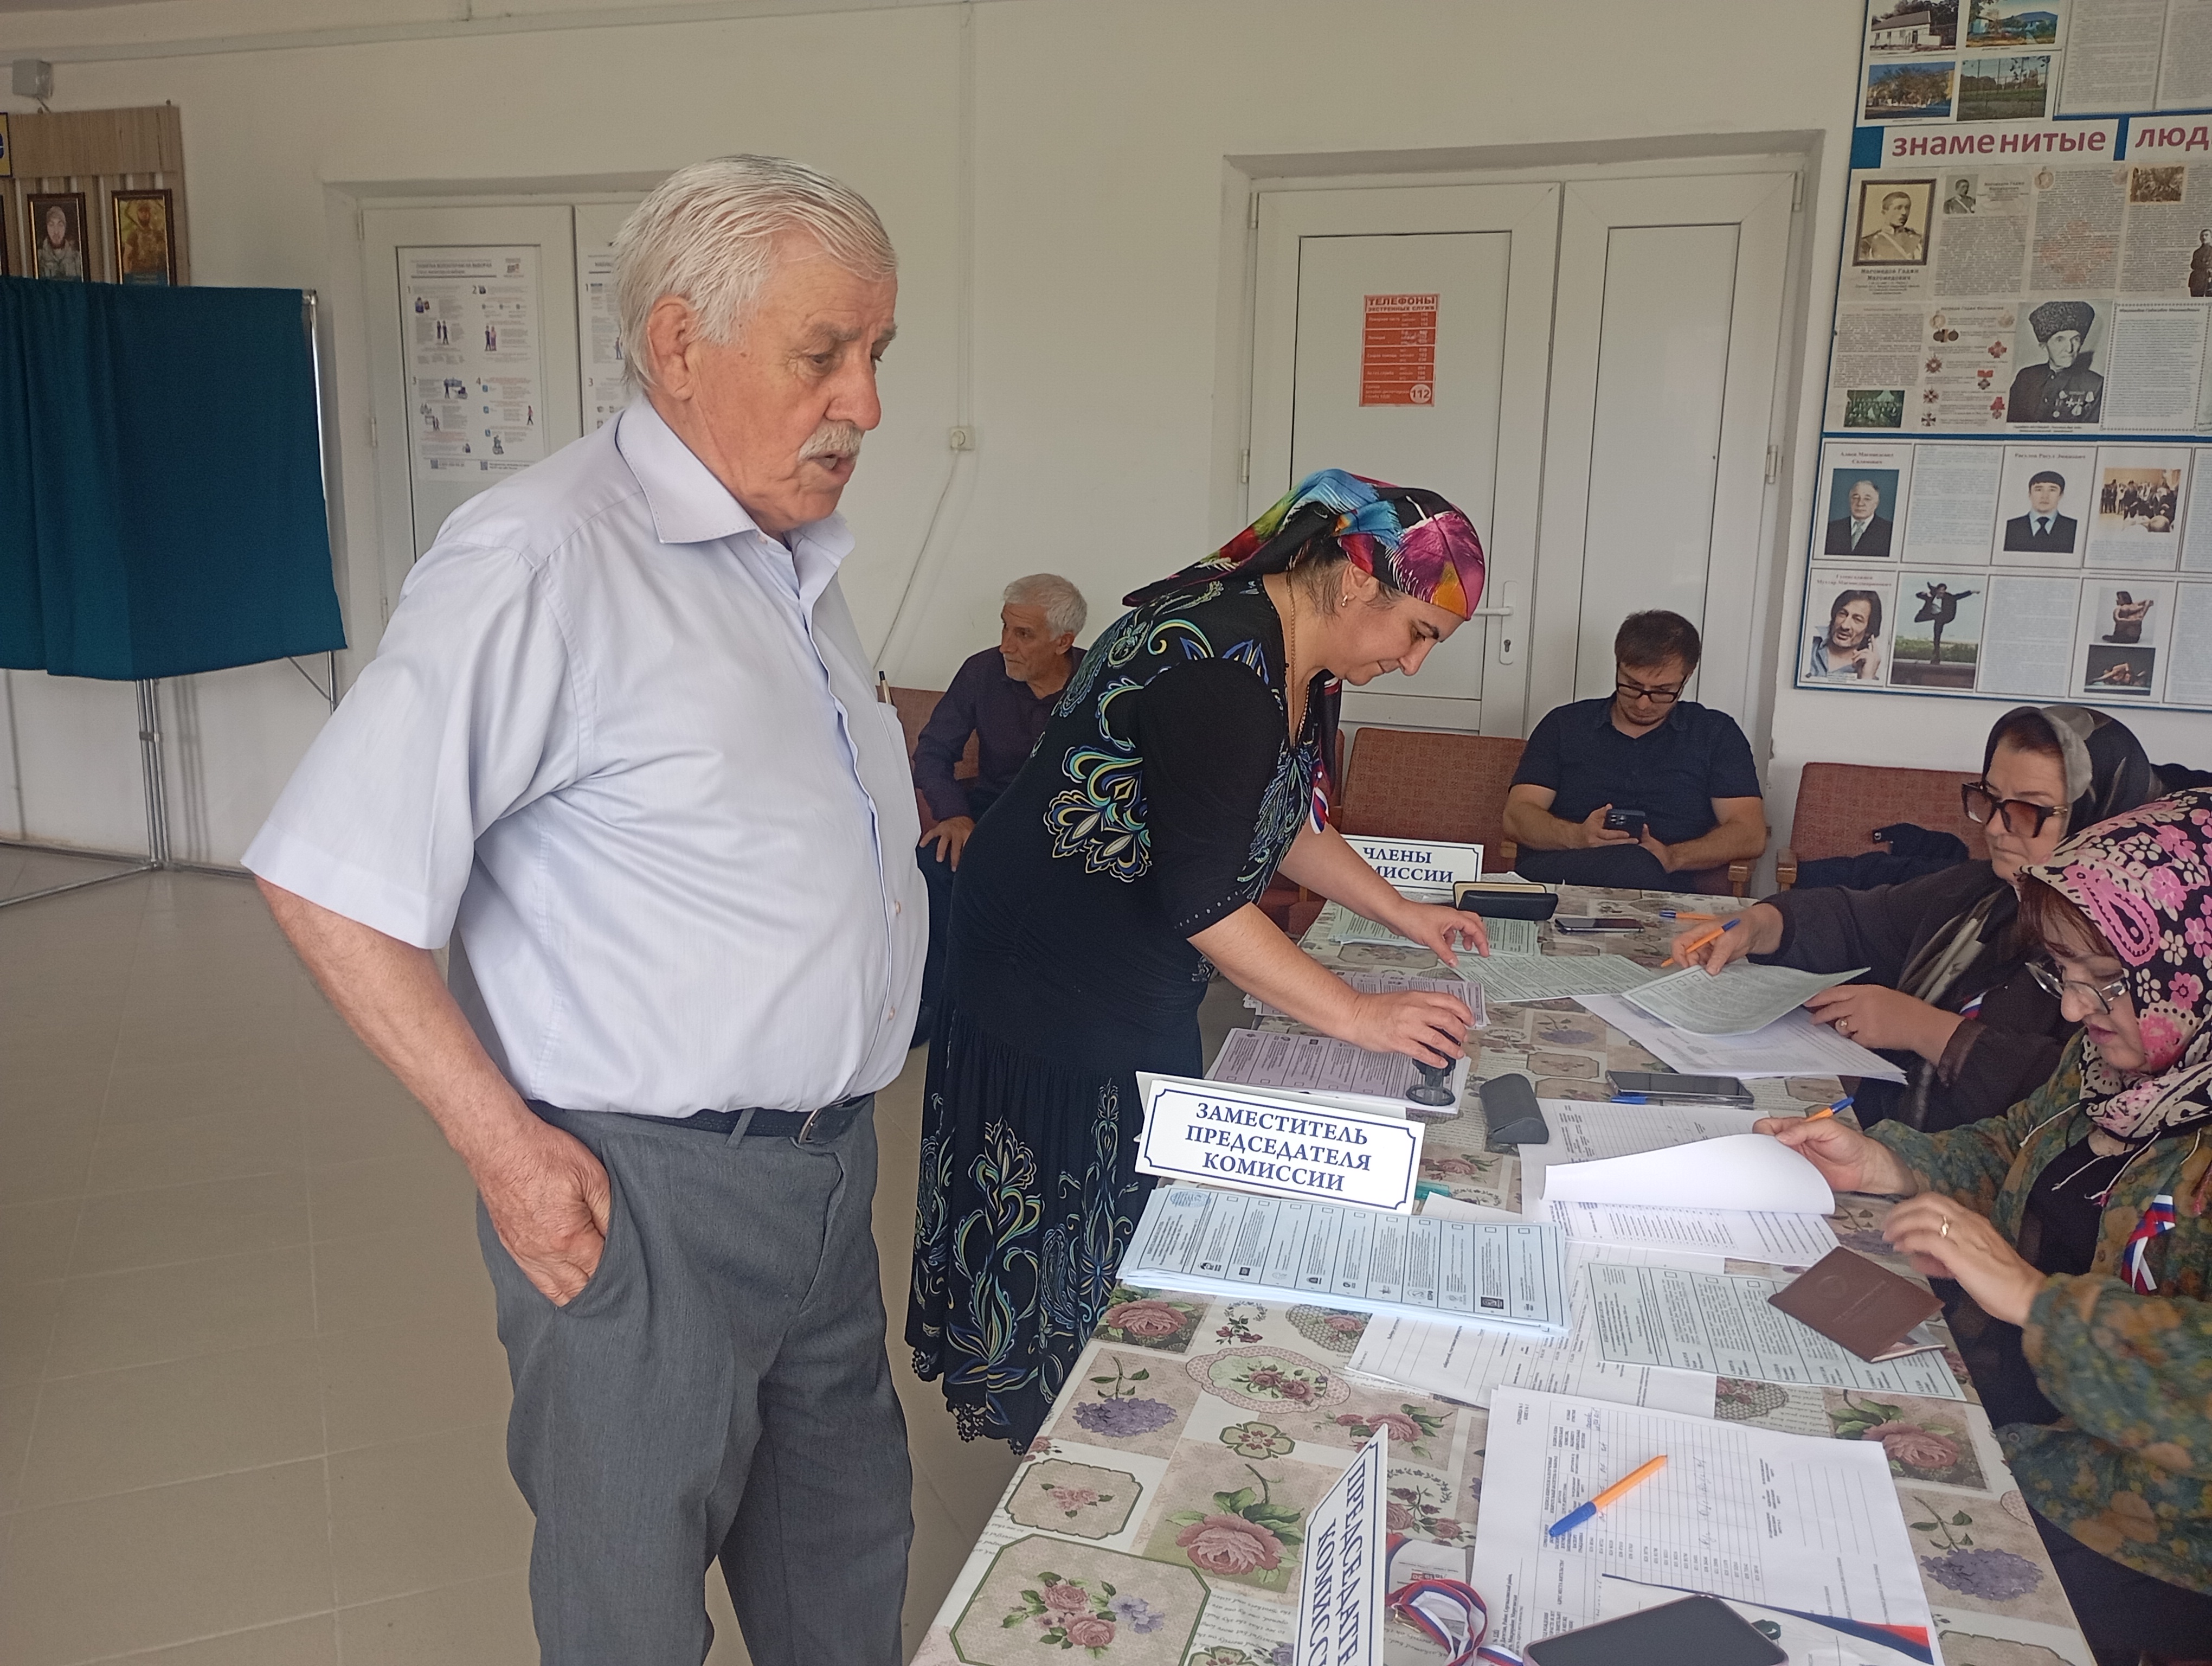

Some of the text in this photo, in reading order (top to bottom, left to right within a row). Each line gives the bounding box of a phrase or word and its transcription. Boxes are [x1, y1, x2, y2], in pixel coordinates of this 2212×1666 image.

[1892, 126, 2212, 157] знаменитые люд
[1368, 297, 1435, 305] ТЕЛЕФОНЫ
[1411, 389, 1430, 399] 112
[1363, 847, 1432, 864] ЧЛЕНЫ
[1369, 866, 1454, 883] МИССИИ
[1196, 1103, 1368, 1145] ЗАМЕСТИТЕЛЬ
[1185, 1124, 1372, 1171] ПРЕДСЕДАТЕЛЯ
[1202, 1152, 1345, 1191] КОМИССИИ
[1334, 1459, 1366, 1666] ПРЕДСЕДАТЕ
[1309, 1517, 1336, 1666] КОМИСС
